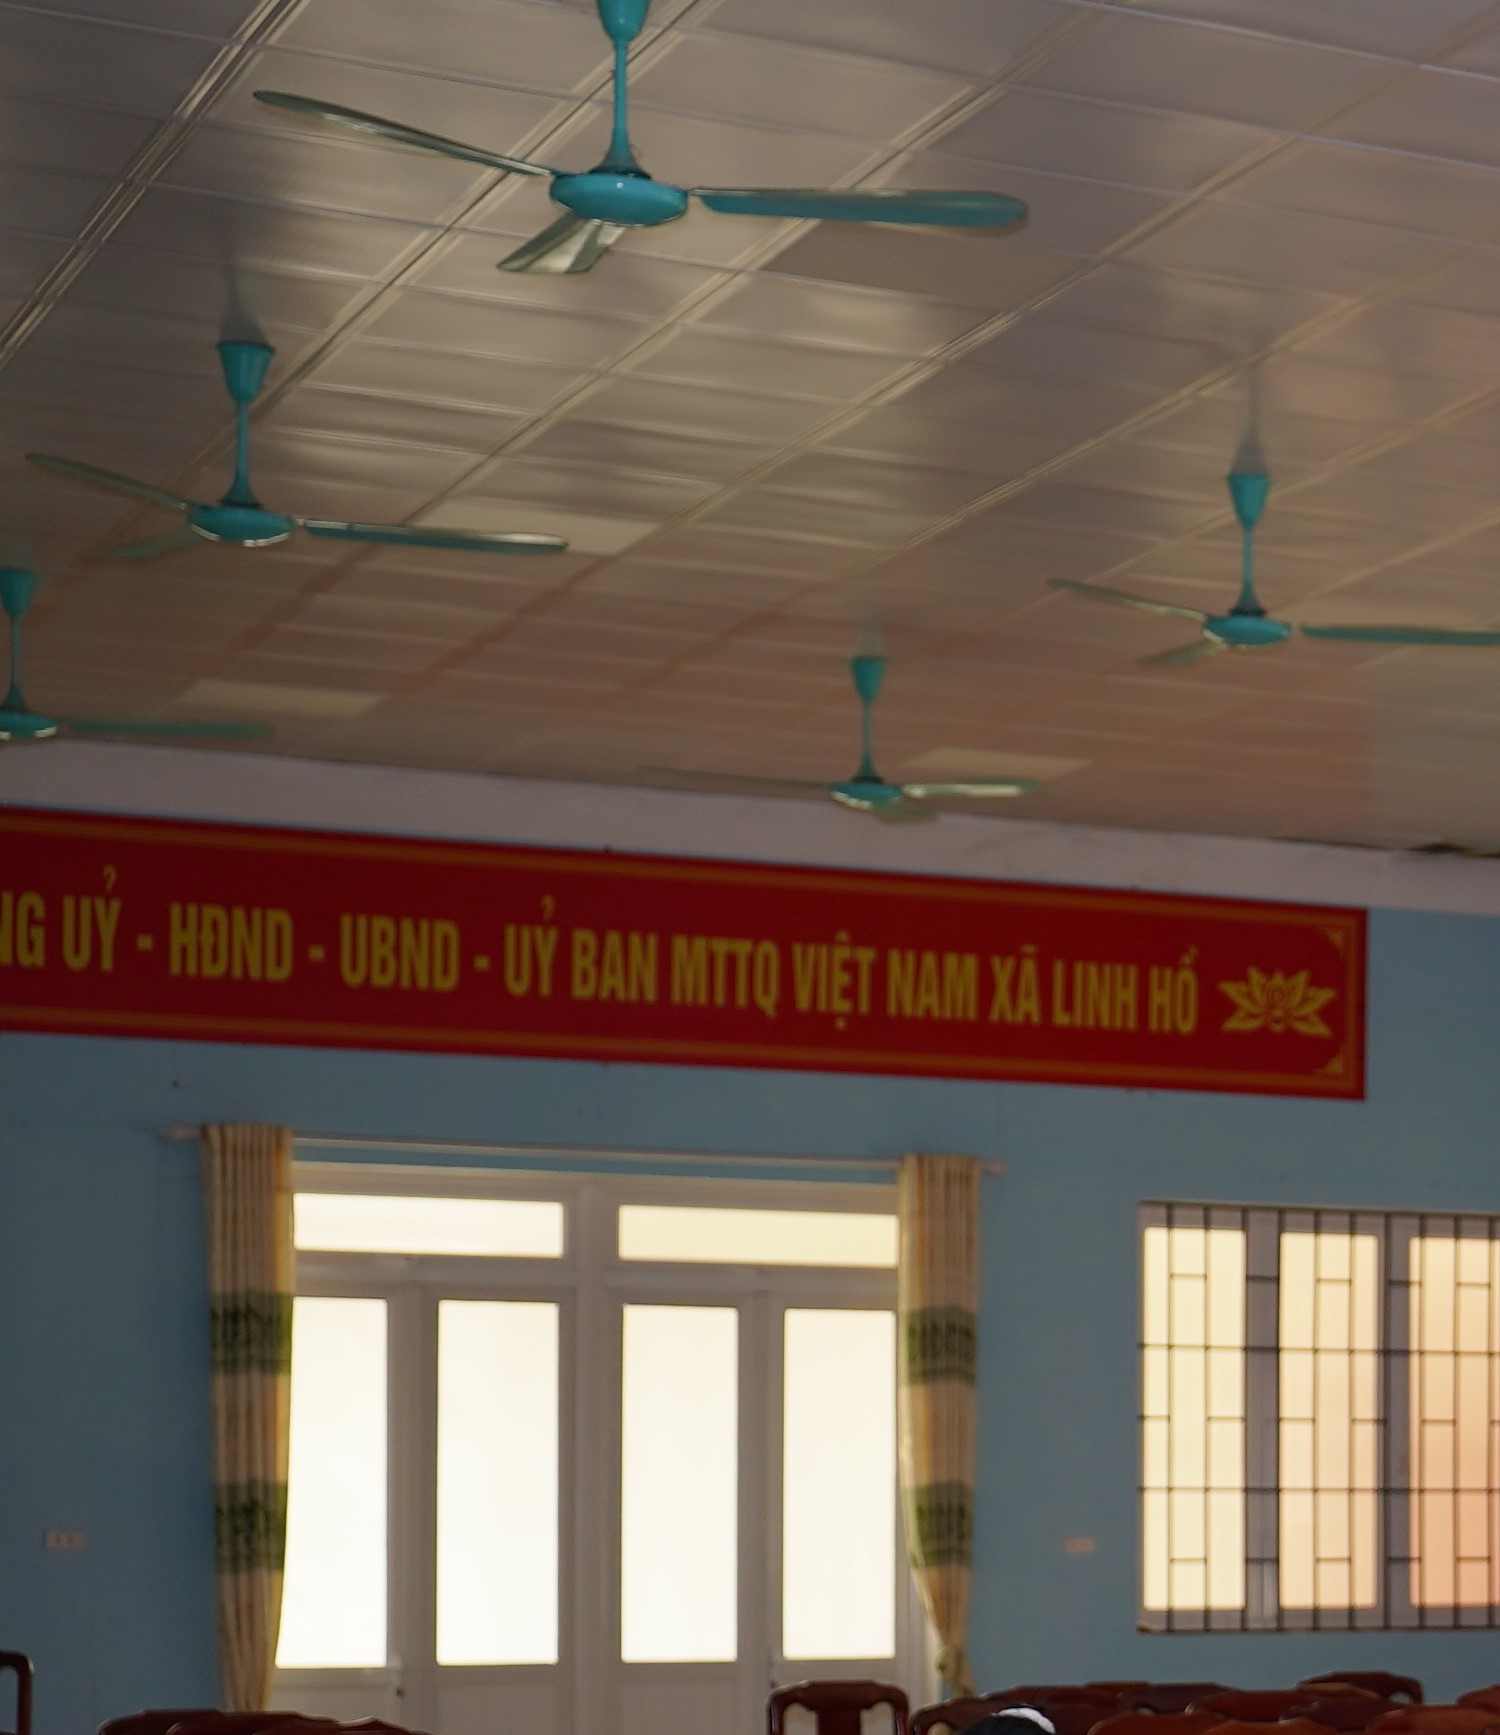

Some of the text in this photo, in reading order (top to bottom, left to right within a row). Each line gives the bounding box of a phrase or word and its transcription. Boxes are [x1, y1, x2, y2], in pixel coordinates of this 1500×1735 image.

[62, 863, 121, 971] UỶ
[137, 935, 153, 950] -
[169, 903, 293, 982] HĐND
[309, 946, 325, 961] -
[341, 914, 459, 992] UBND
[474, 956, 490, 971] -
[504, 895, 558, 997] UỶ
[572, 928, 658, 1003] BAN
[671, 934, 780, 1018] MTTQ
[792, 930, 876, 1030] VIỆT
[887, 948, 980, 1021] NAM
[988, 944, 1041, 1025] XÃ
[1052, 960, 1139, 1031] LINH
